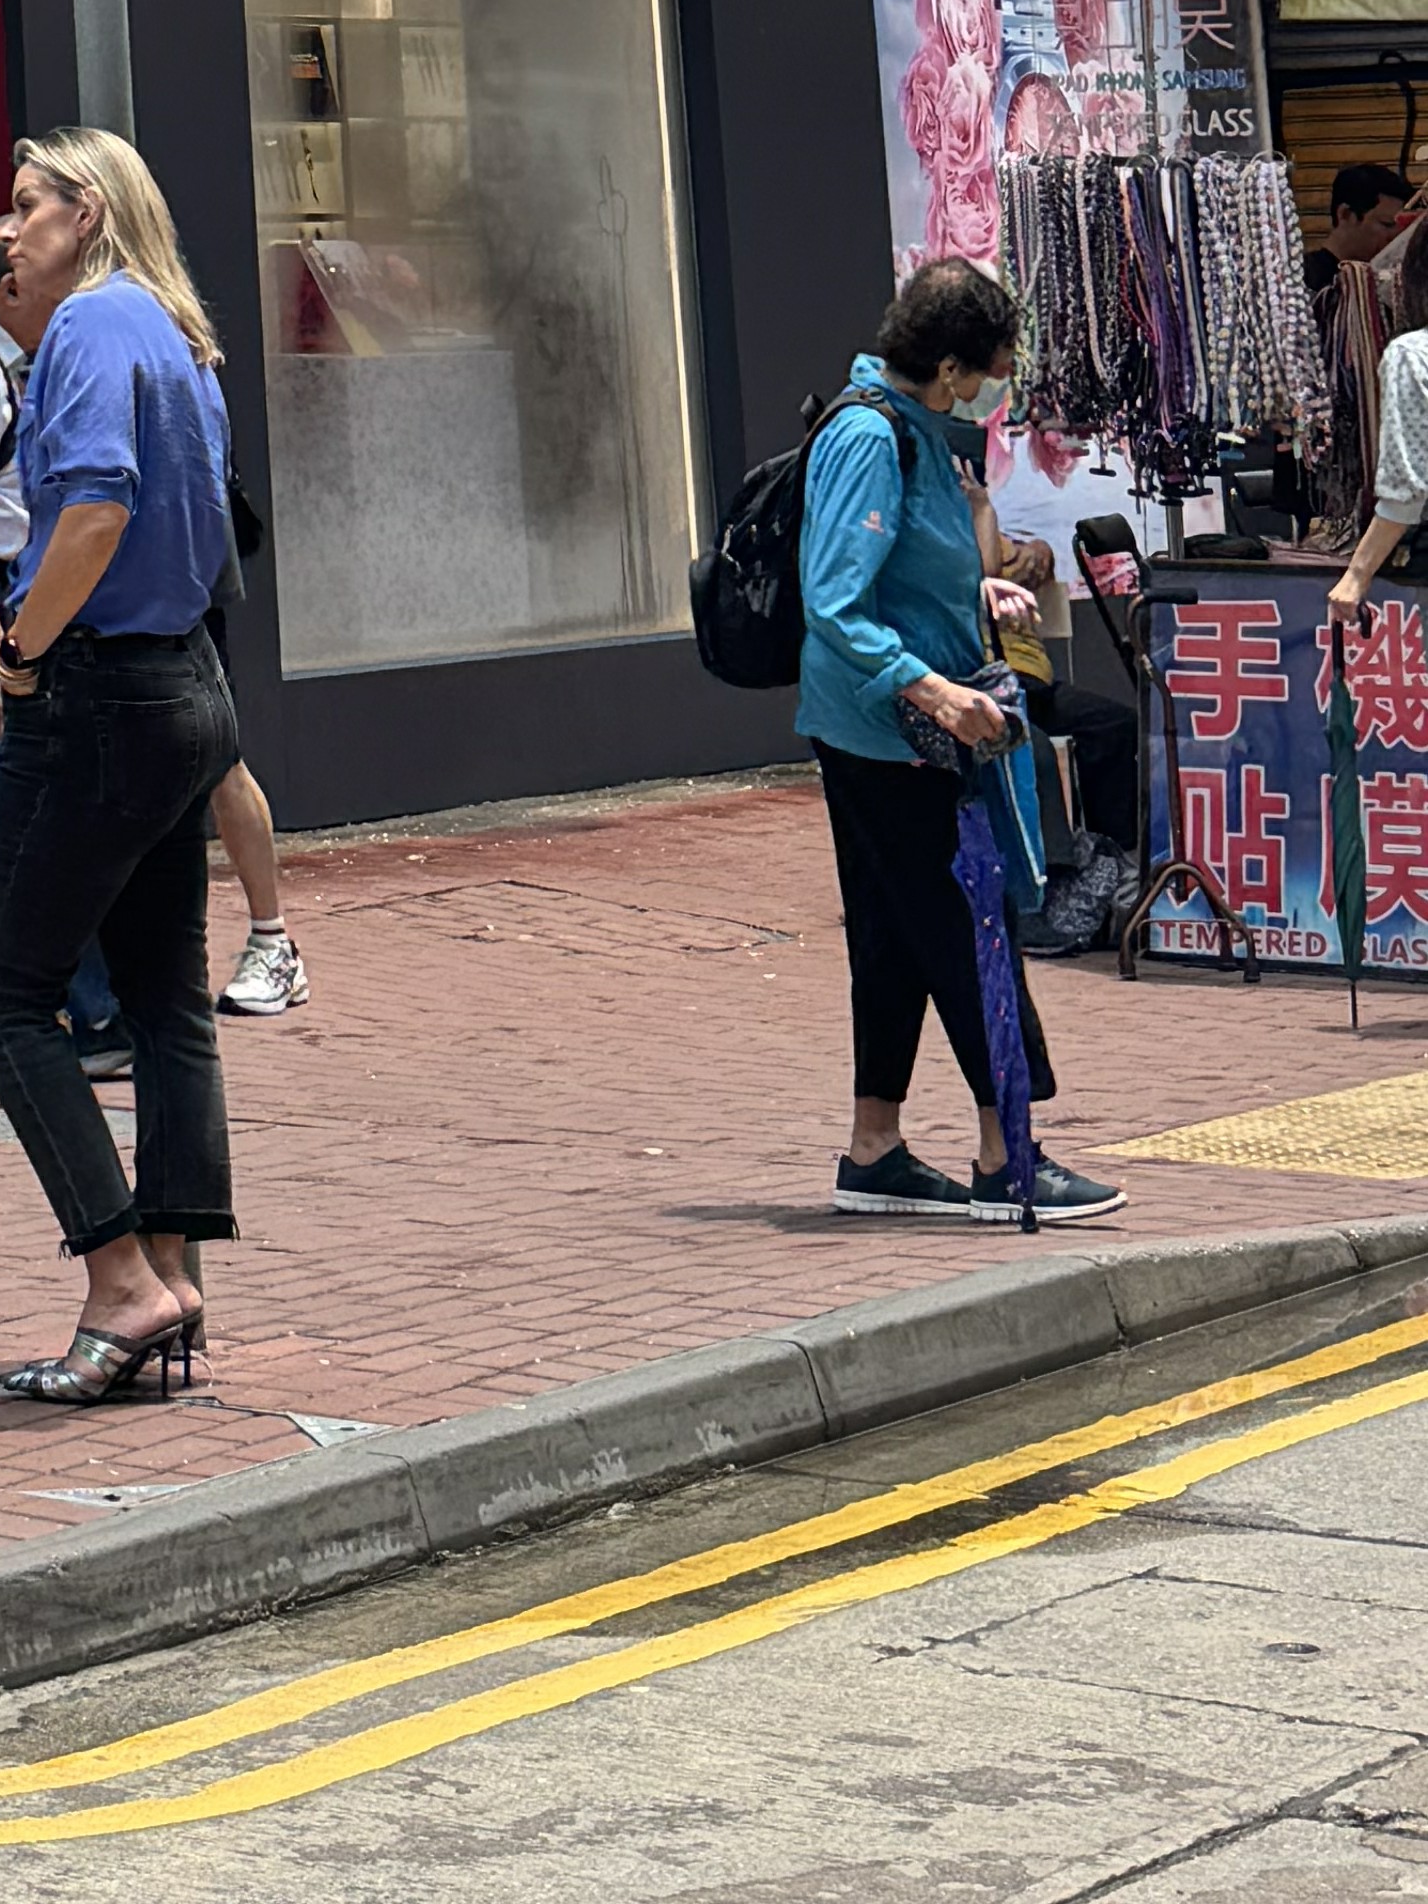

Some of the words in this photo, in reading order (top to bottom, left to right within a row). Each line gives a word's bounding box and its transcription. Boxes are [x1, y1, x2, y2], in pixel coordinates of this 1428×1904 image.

[1162, 68, 1247, 91] SAMSUNG
[1182, 107, 1255, 137] GLASS
[1158, 920, 1327, 958] TEMPERED
